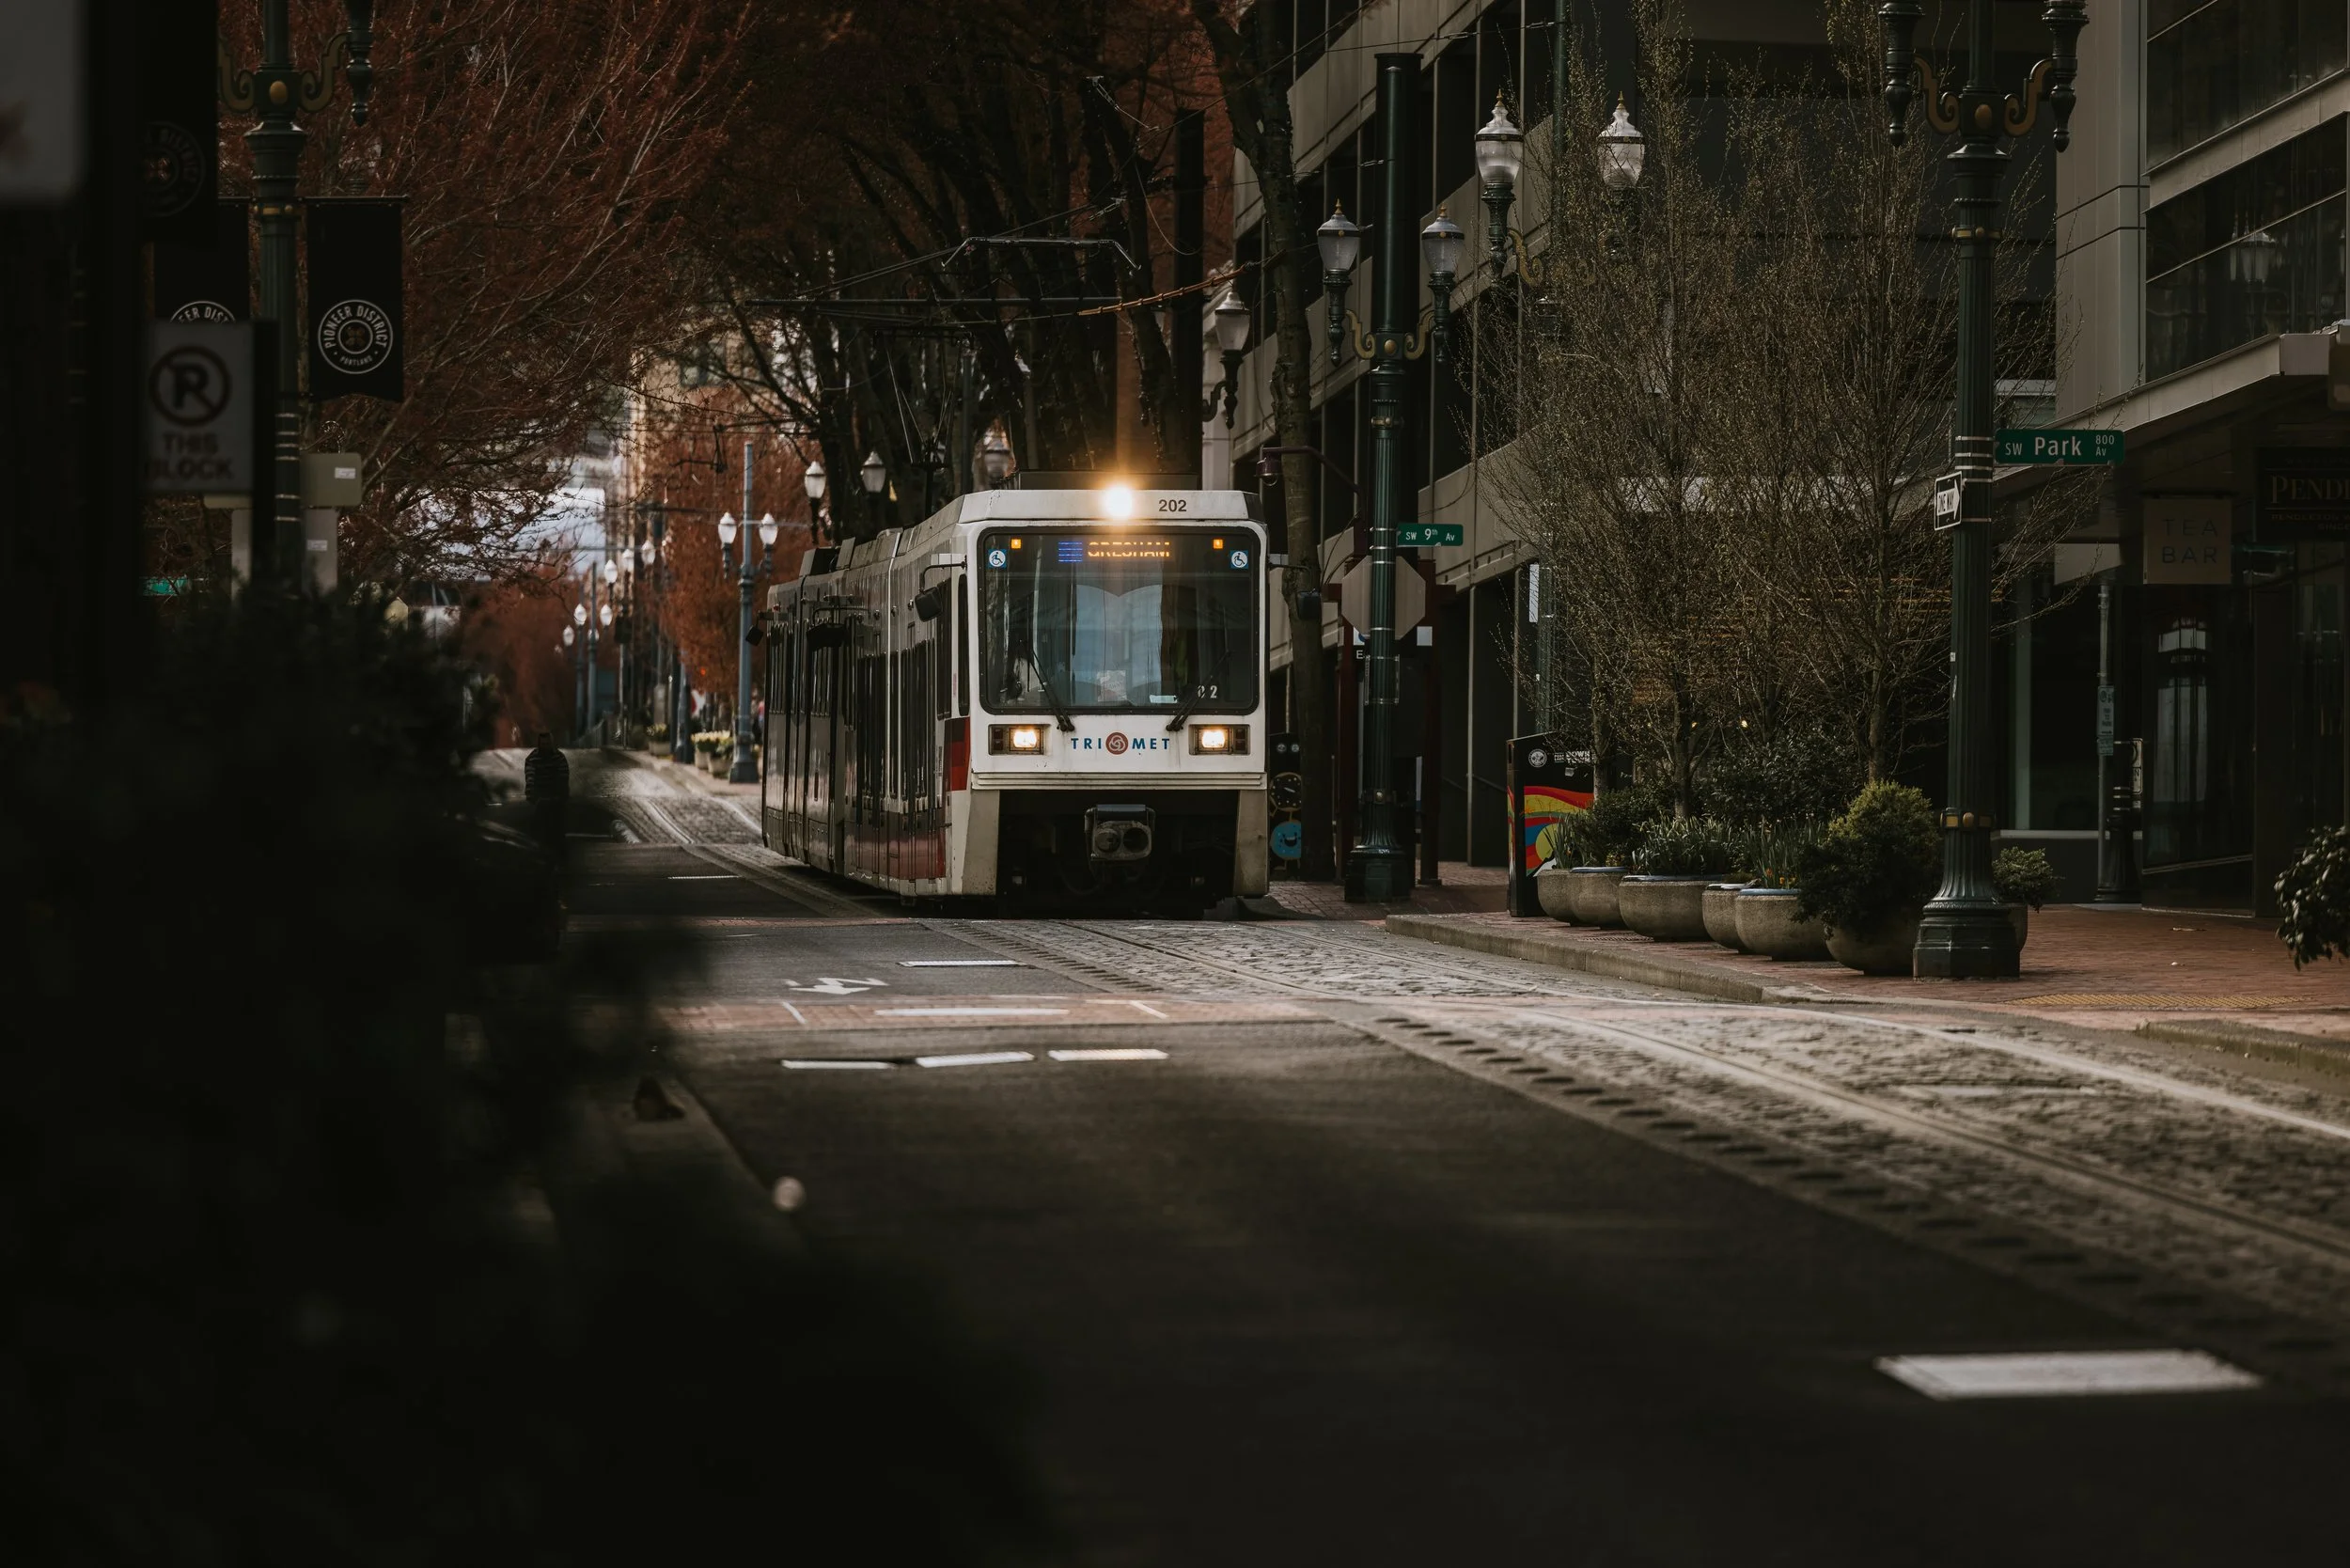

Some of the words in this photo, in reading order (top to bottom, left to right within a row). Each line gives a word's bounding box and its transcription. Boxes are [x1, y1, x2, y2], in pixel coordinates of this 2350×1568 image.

[323, 306, 352, 349] PIONEER
[356, 306, 388, 349] DISTRICT
[2005, 442, 2023, 456] SW
[2034, 435, 2082, 456] Park
[2095, 447, 2107, 457] Av
[2095, 434, 2115, 445] 800
[1159, 499, 1187, 512] 202
[1405, 531, 1418, 541] SW
[1424, 527, 1438, 541] 9th
[1445, 532, 1455, 541] Av
[2161, 518, 2218, 538] TEA
[2162, 546, 2217, 564] BAR
[1071, 738, 1102, 750] TRI
[1132, 738, 1170, 750] MET
